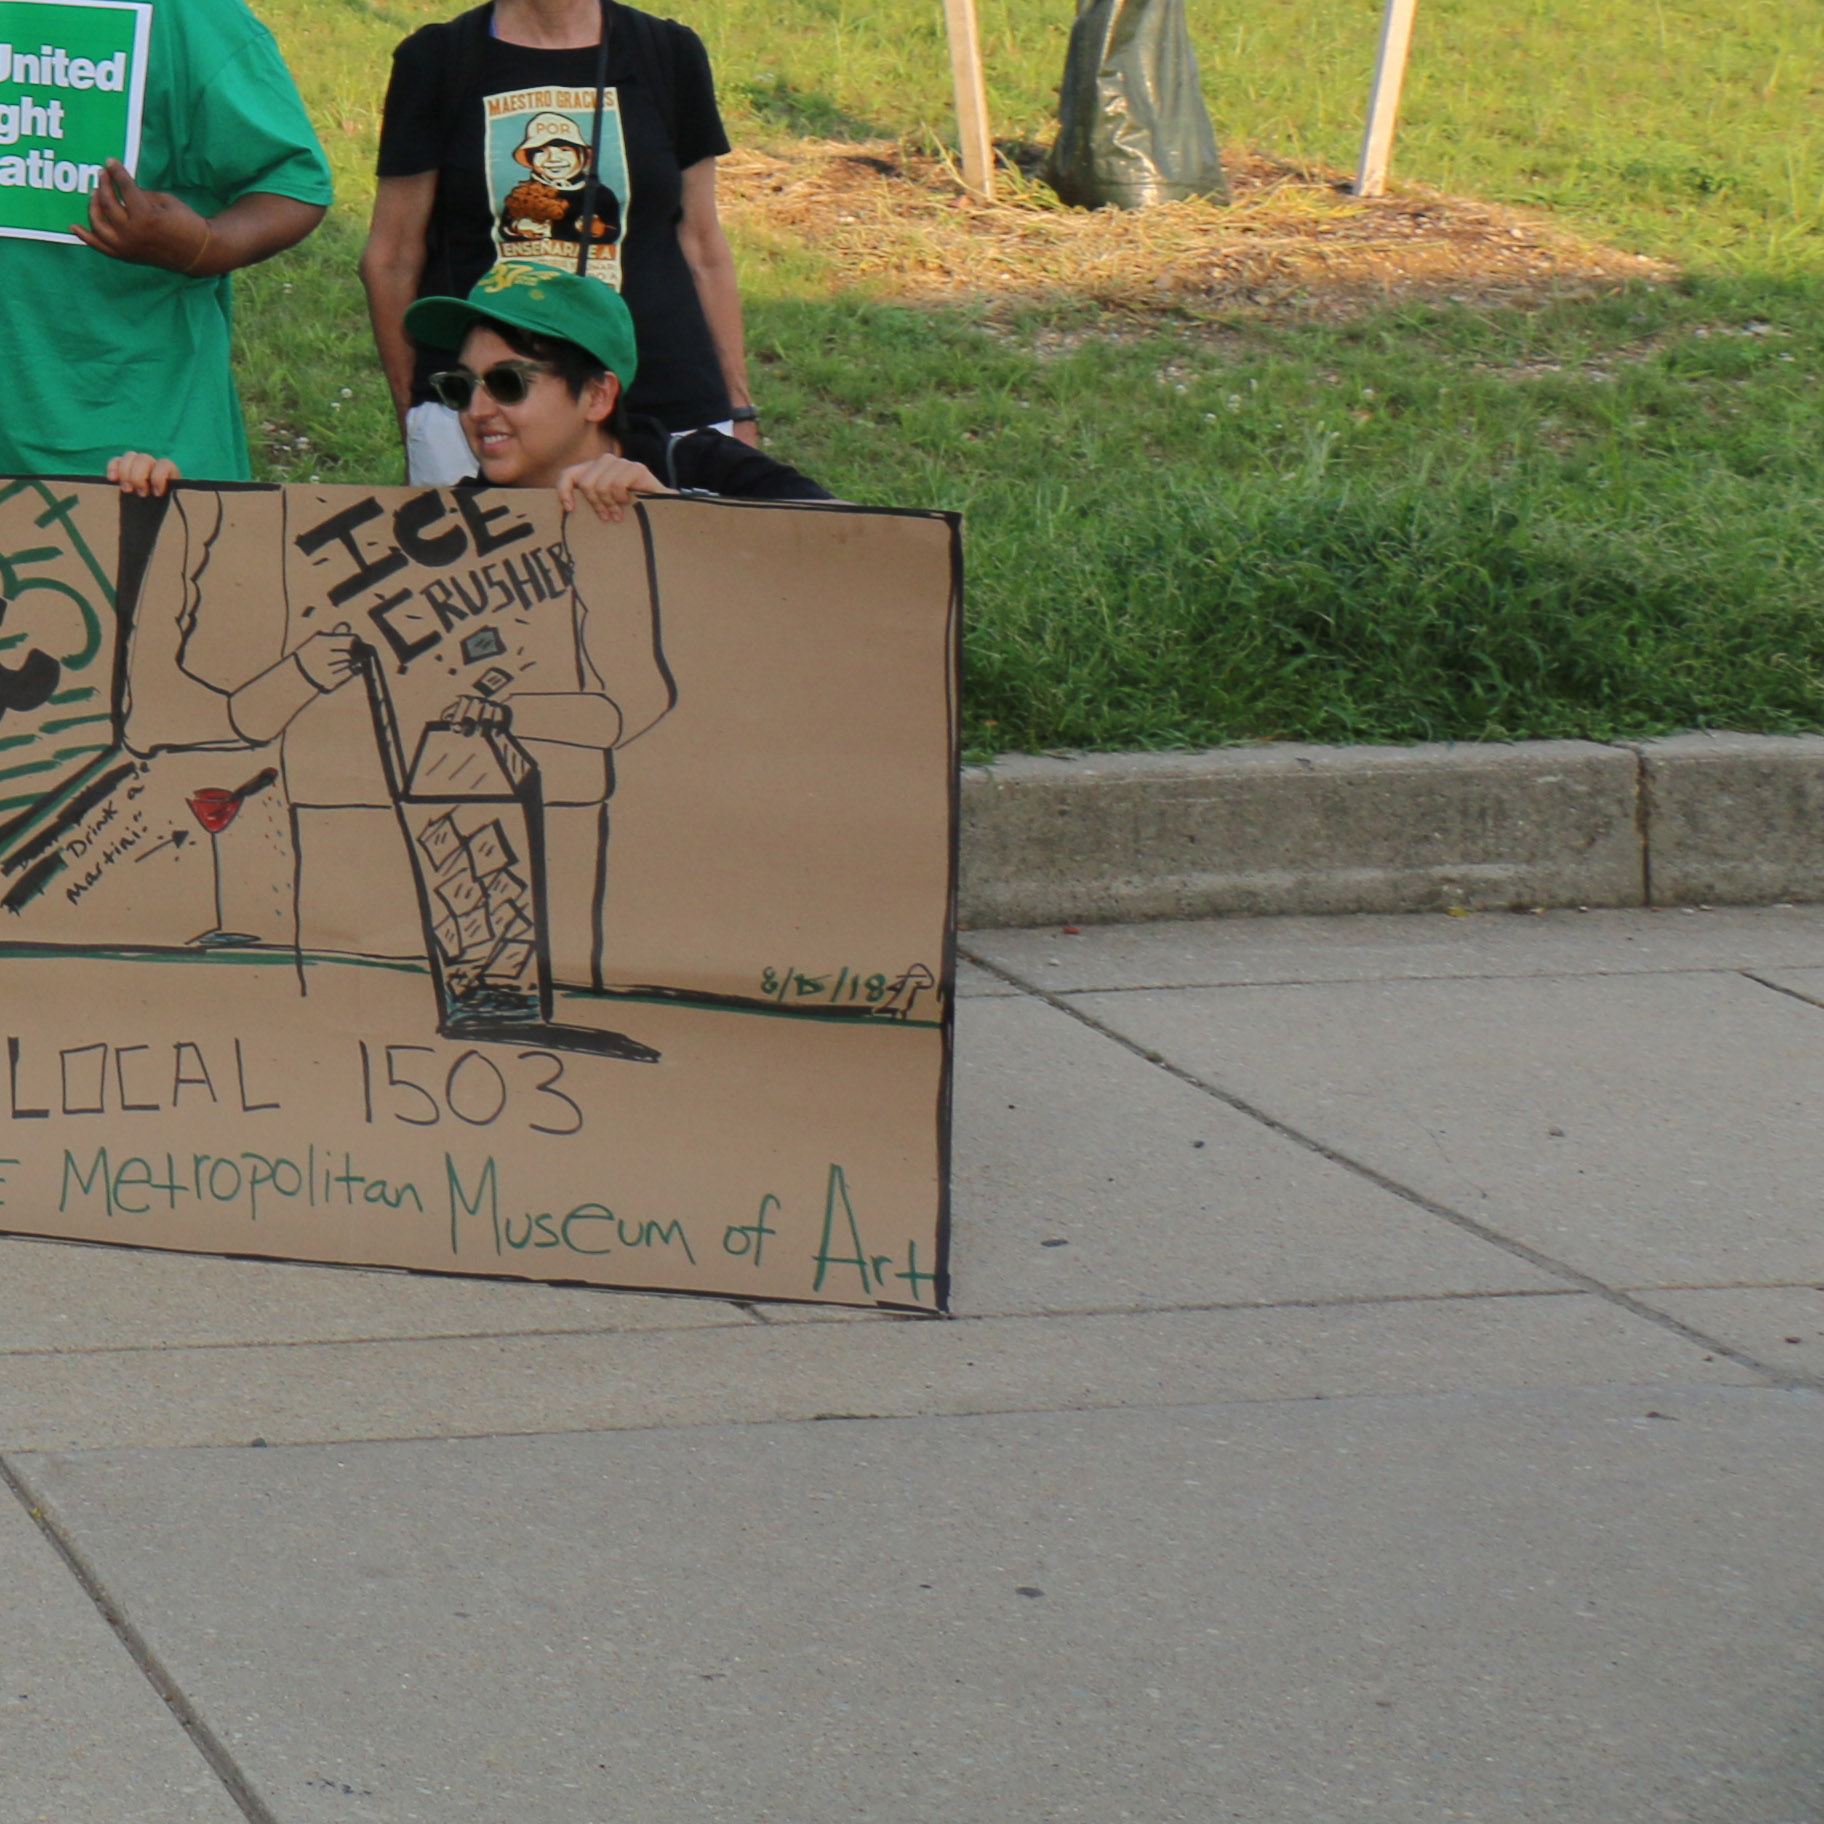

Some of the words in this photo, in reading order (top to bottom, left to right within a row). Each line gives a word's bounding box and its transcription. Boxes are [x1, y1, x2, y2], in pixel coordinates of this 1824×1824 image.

[488, 90, 552, 116] MAESTRO
[556, 90, 614, 109] GRACIS
[536, 122, 572, 135] POR
[294, 488, 535, 608] ICE
[367, 541, 574, 665] CRUSHER
[66, 800, 118, 858] Drink
[7, 1036, 282, 1119] LOCAL
[358, 1039, 584, 1136] 1503
[59, 1143, 424, 1220] Metropolitan
[445, 1150, 696, 1265] Museum
[722, 1192, 781, 1266] of
[812, 1162, 939, 1301] Art
